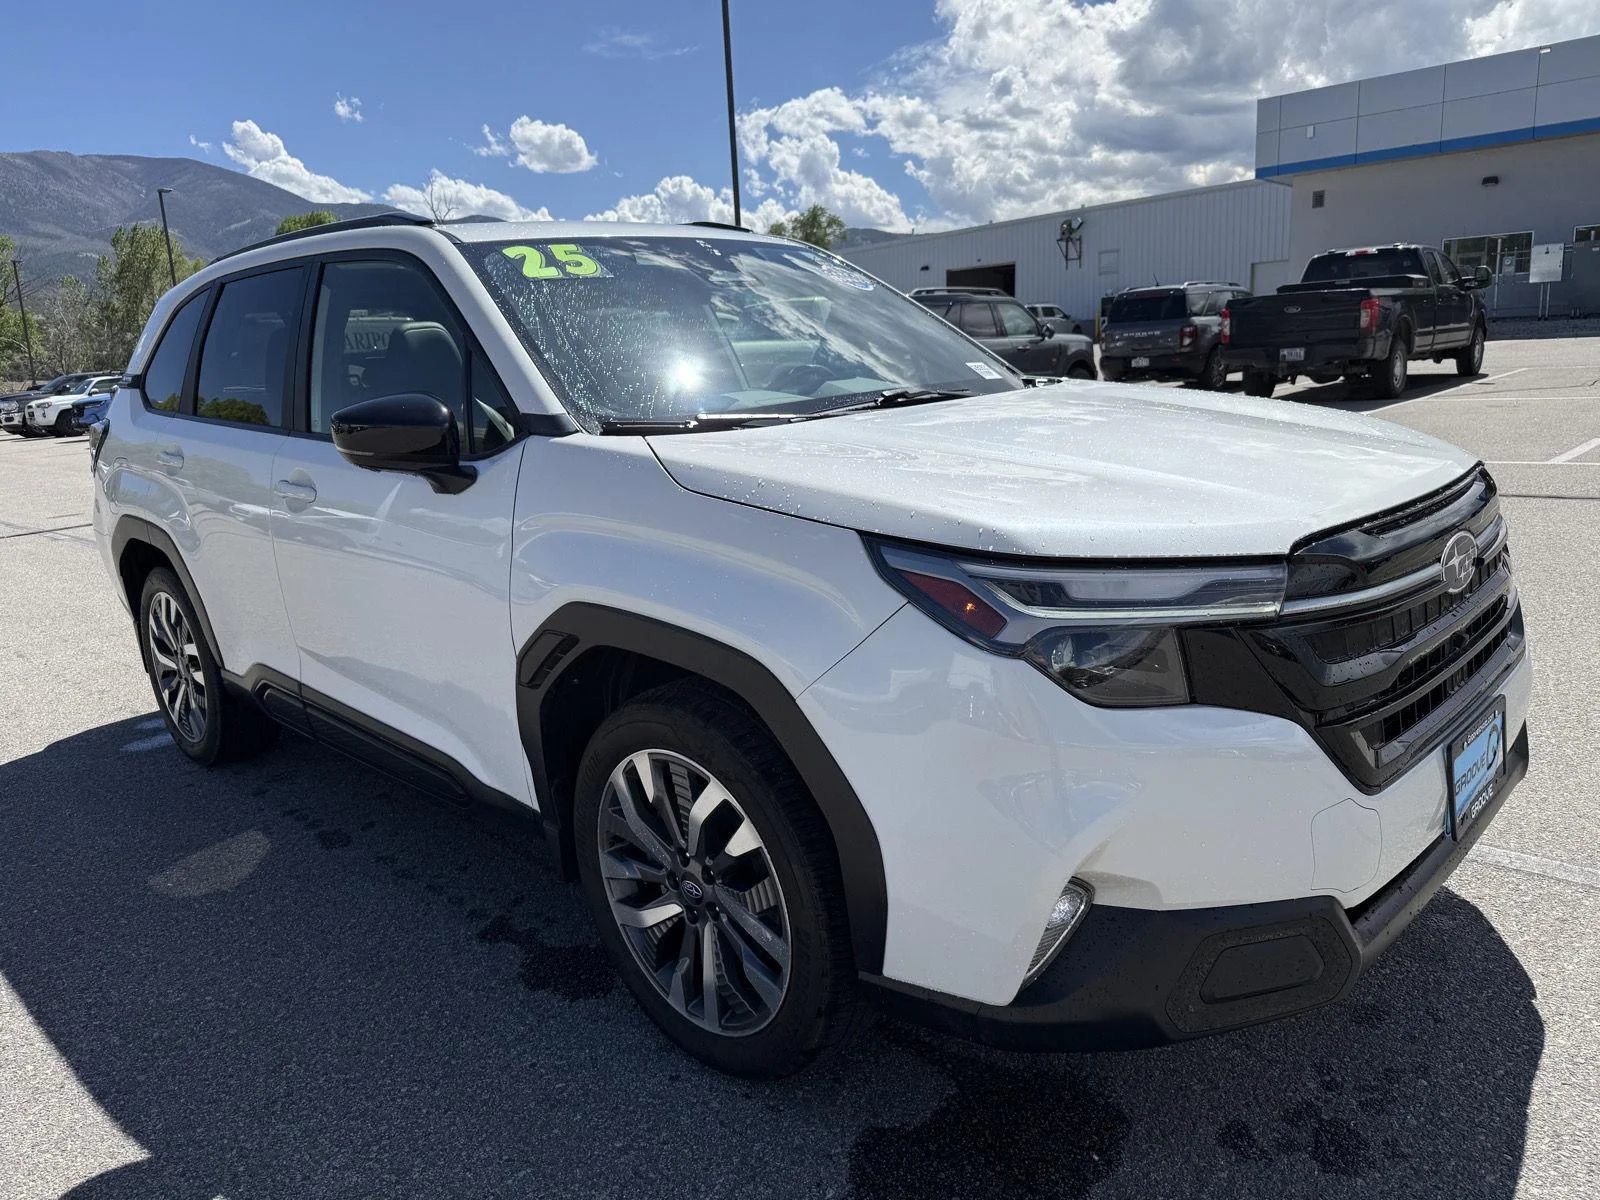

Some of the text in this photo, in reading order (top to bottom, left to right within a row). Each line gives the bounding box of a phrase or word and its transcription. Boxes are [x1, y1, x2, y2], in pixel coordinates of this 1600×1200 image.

[502, 244, 601, 279] 25
[1455, 750, 1486, 796] GROOVE
[1471, 783, 1494, 819] GROOVE
